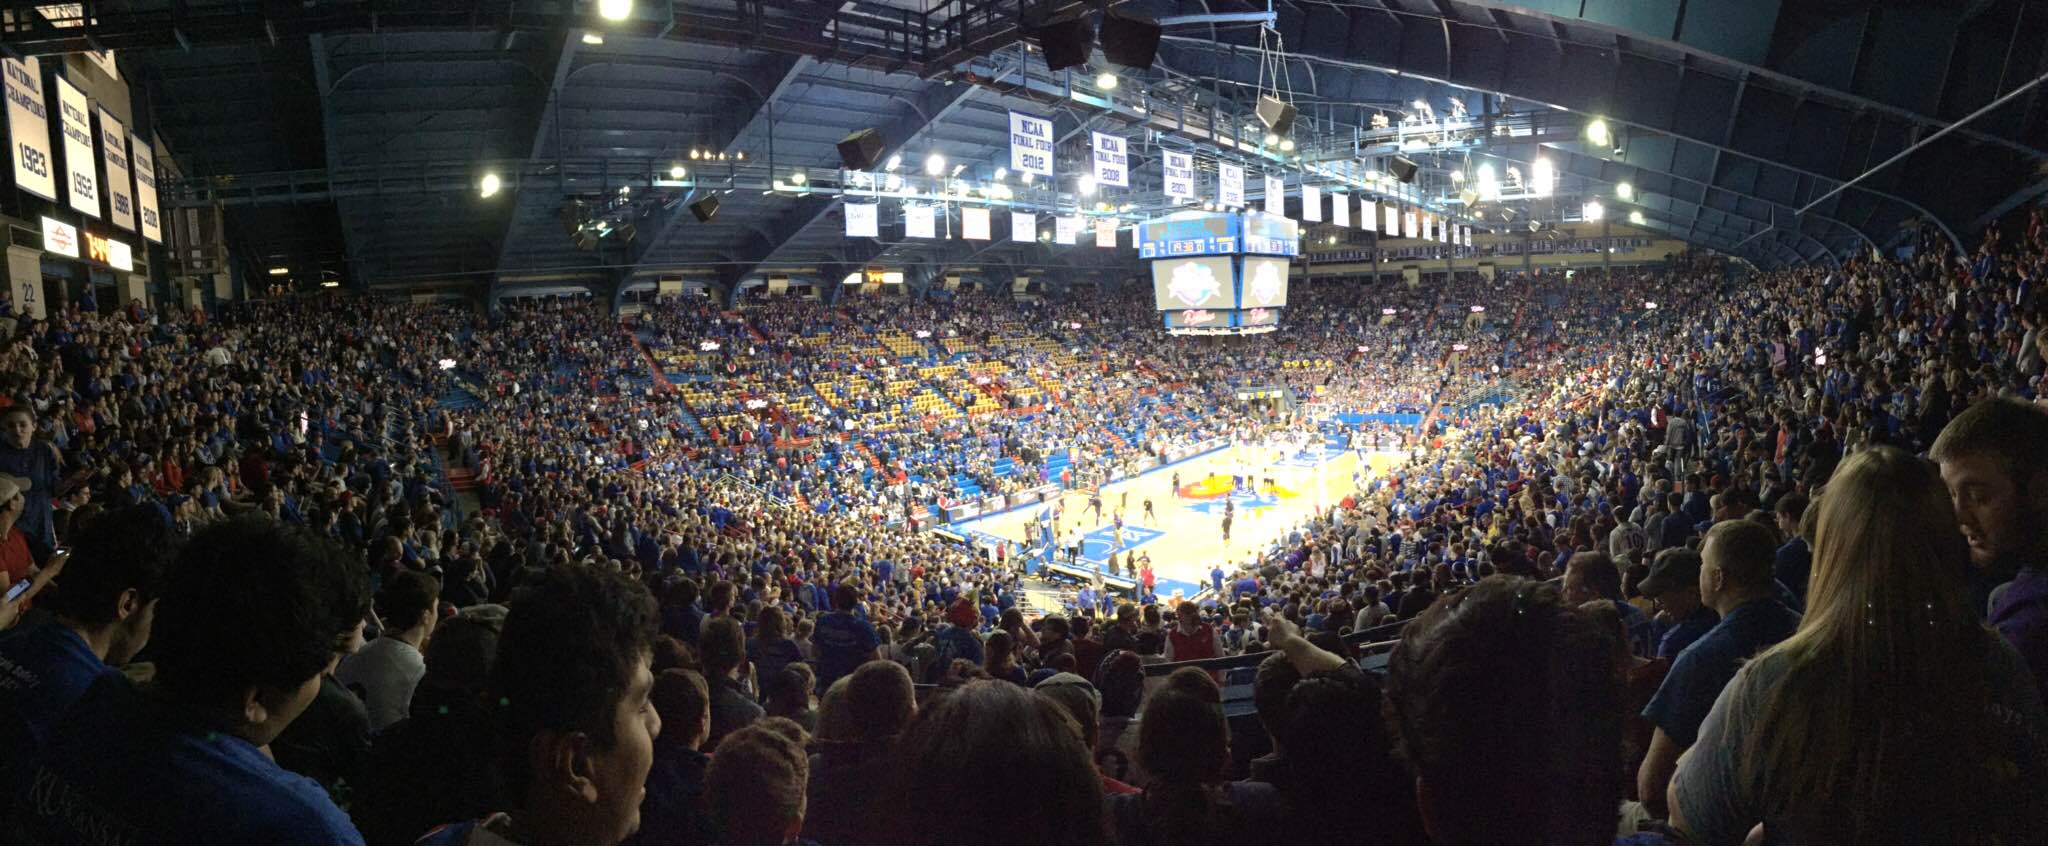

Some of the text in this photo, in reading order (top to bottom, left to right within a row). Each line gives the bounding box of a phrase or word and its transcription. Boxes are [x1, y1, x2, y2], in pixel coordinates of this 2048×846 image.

[1022, 119, 1044, 138] NCAA
[1013, 133, 1052, 152] FINAL FOUR
[1101, 138, 1119, 153] NCAA
[19, 142, 47, 178] 1923
[1022, 154, 1044, 170] 2012
[1095, 151, 1111, 163] FINAL
[1102, 168, 1120, 182] 2008
[73, 171, 94, 200] 1952
[23, 280, 35, 302] 22
